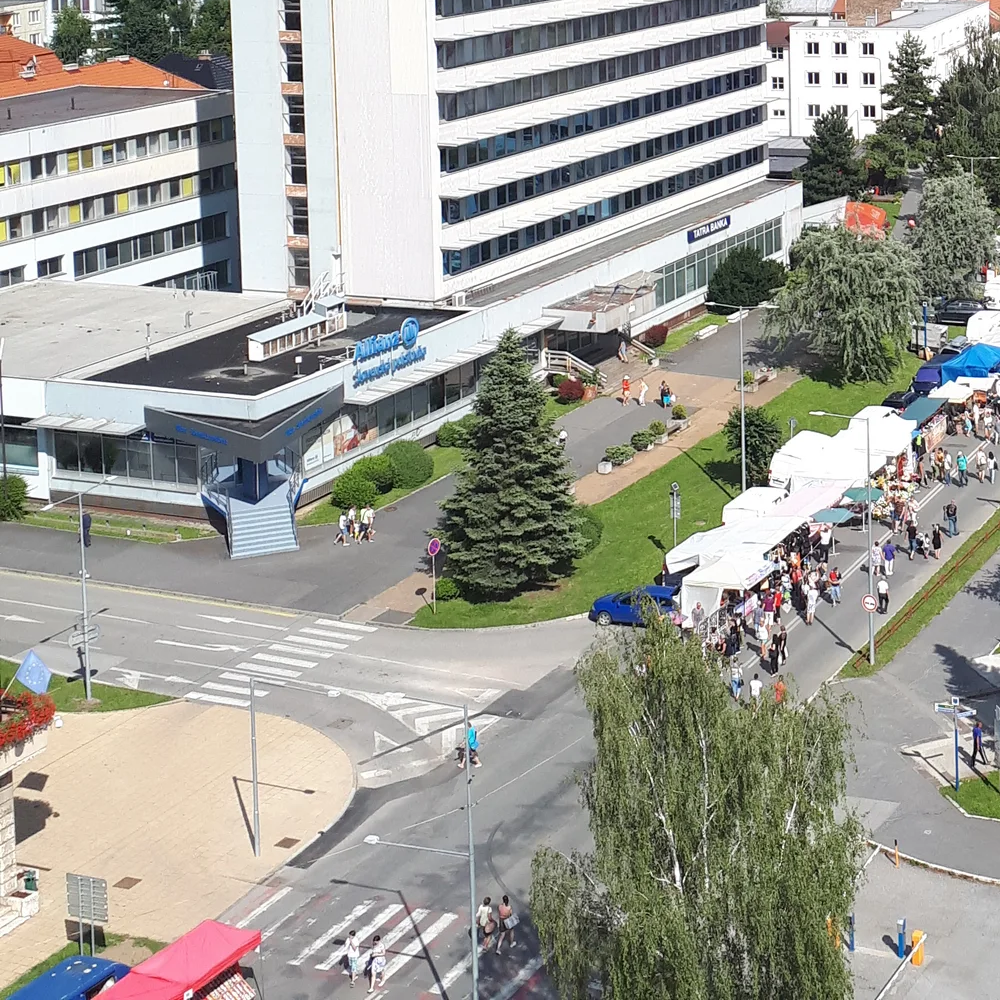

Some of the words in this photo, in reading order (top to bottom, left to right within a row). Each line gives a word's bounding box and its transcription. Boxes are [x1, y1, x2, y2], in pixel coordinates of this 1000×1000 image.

[693, 225, 710, 238] TATRA
[710, 218, 728, 232] BANKA
[354, 330, 399, 361] Allianz
